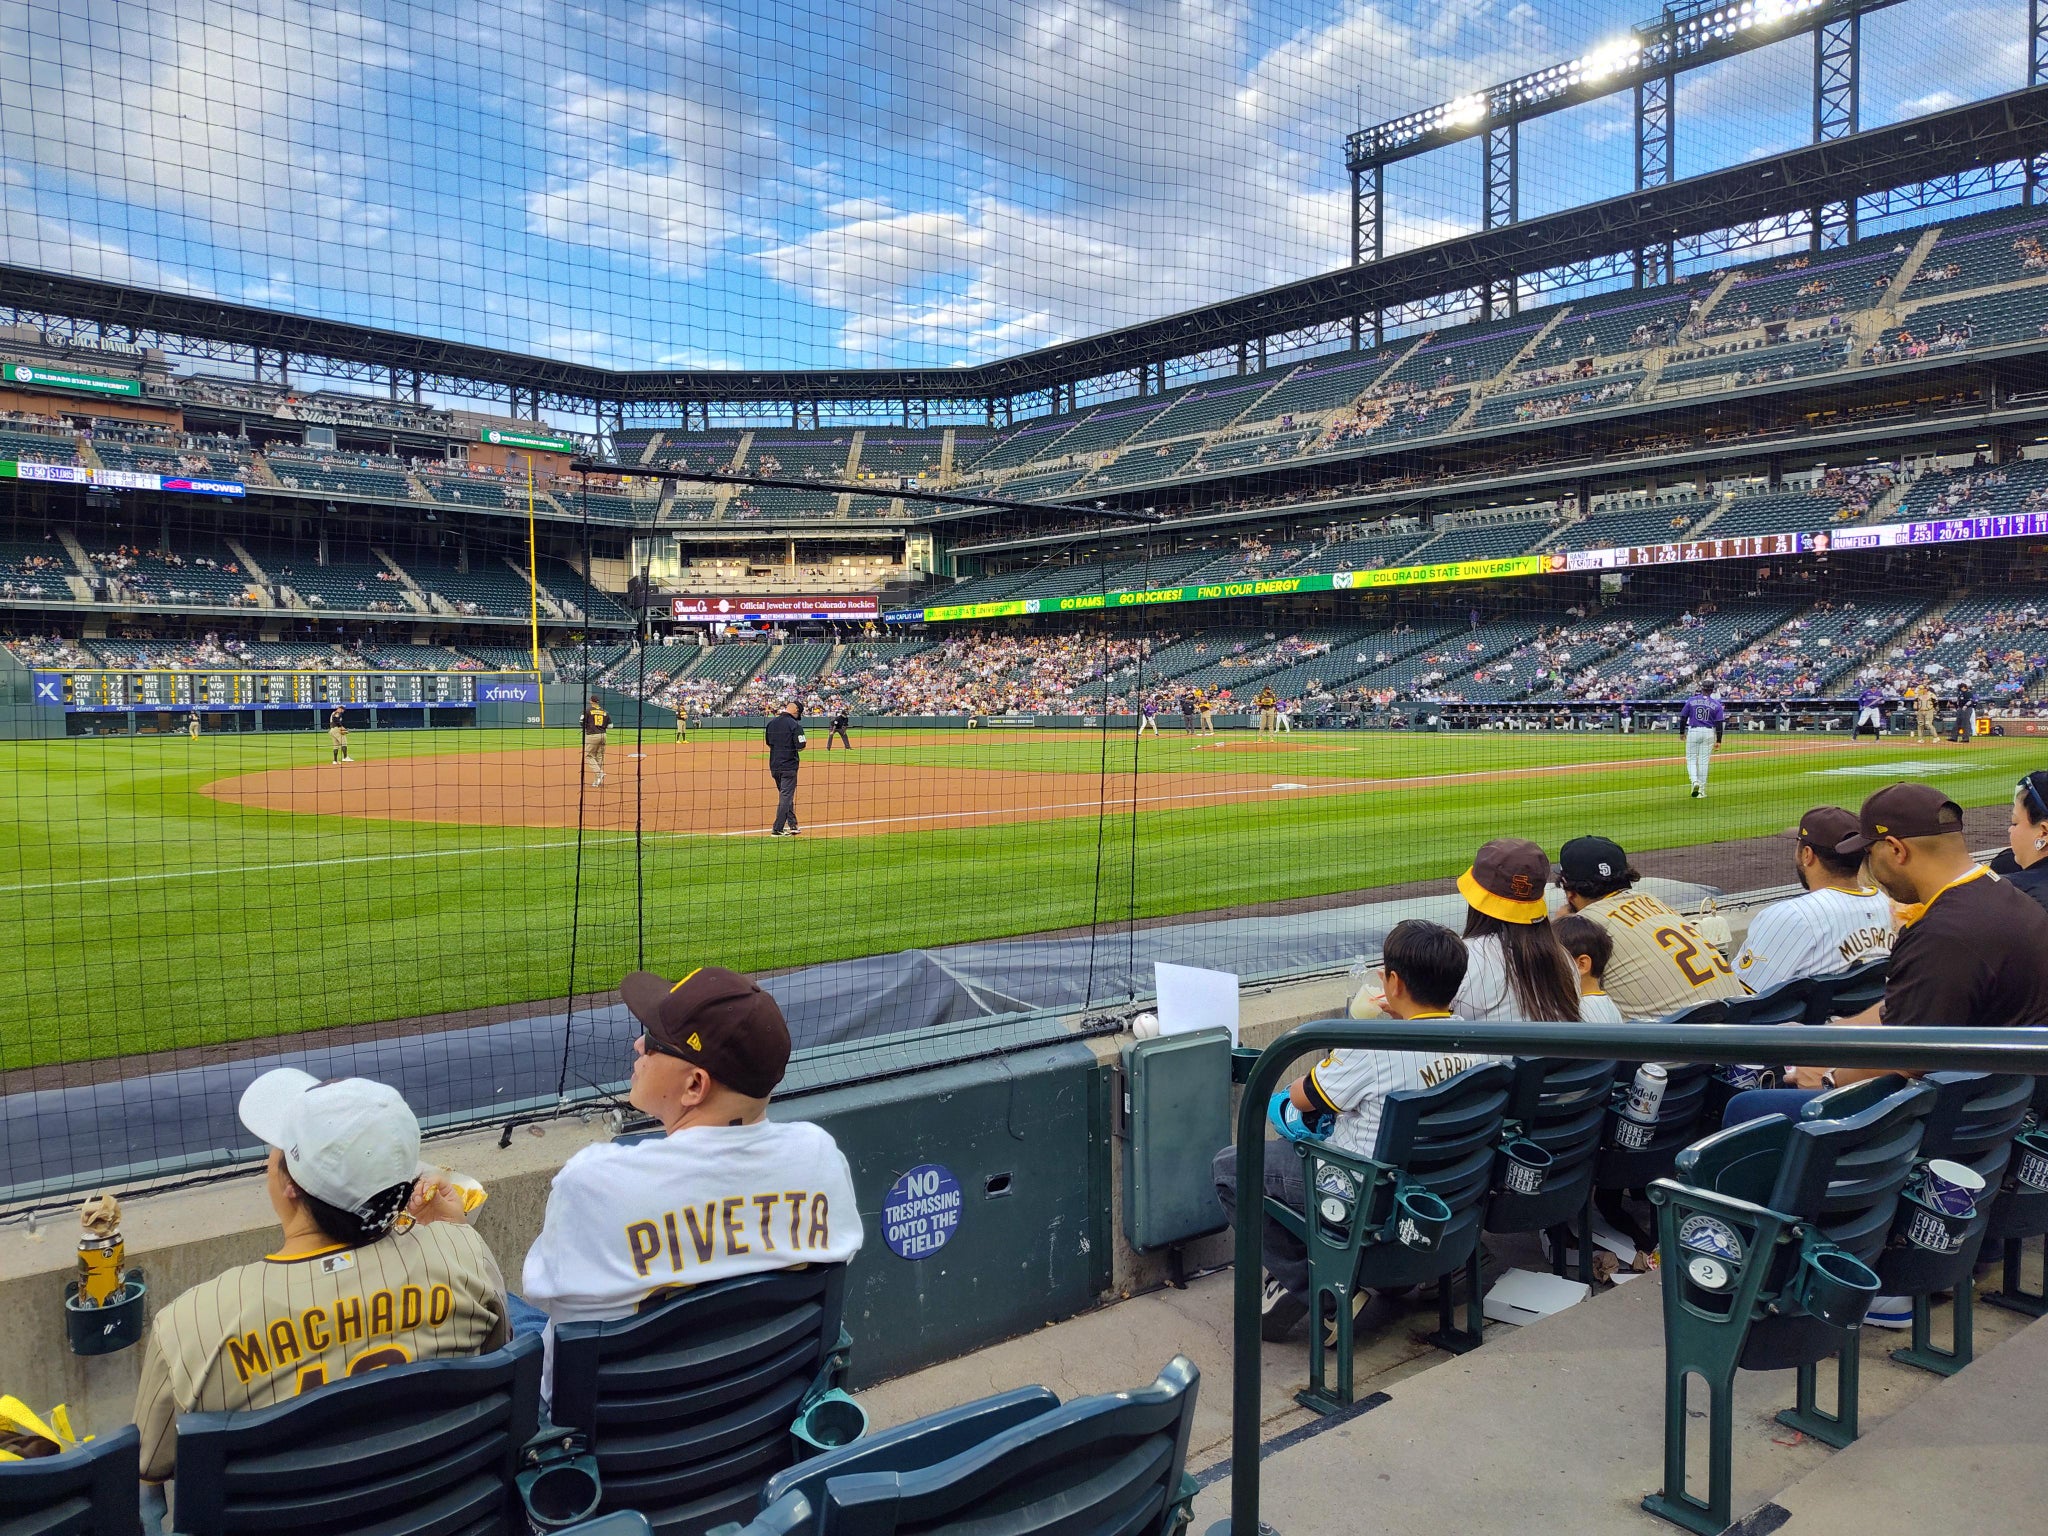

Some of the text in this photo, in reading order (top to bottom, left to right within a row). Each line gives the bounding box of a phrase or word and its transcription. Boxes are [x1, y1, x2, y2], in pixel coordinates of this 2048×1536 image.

[69, 333, 99, 349] JACK
[34, 372, 70, 384] COLORADO
[92, 380, 130, 391] UNIVERSITY
[298, 408, 339, 425] Silver
[339, 418, 360, 426] BULLET
[502, 436, 524, 444] COLORADO
[192, 482, 243, 494] EMPOWER
[1940, 528, 1969, 540] 20/79
[2017, 523, 2024, 533] 3
[2035, 522, 2046, 532] 11
[1834, 535, 1876, 548] RUMFIELD
[1911, 530, 1931, 542] .253
[1686, 549, 1702, 560] 22.1
[1716, 548, 1721, 557] 6
[1756, 545, 1761, 554] 8
[1776, 543, 1787, 552] 25
[1659, 551, 1676, 562] 2.42
[1373, 569, 1427, 583] COLORADO
[1429, 566, 1460, 578] STATE
[1464, 561, 1529, 575] UNIVERSITY
[1060, 579, 1301, 609] GO RAMS! GO ROCKIES! FIND YOUR ENERGY
[766, 602, 793, 610] Jeweler
[928, 609, 957, 618] COLORADO
[977, 605, 1012, 614] UNIVERSITY
[485, 687, 527, 700] xfinity
[594, 715, 603, 726] 13
[1696, 706, 1710, 720] 81
[1608, 896, 1664, 928] TATIS
[1619, 1121, 1643, 1137] COORS
[1617, 1130, 1641, 1147] FIELD
[1509, 1162, 1535, 1181] COORS
[2020, 1166, 2048, 1189] FIEL
[908, 1170, 940, 1200] NO
[1507, 1172, 1533, 1192] FIELD
[885, 1190, 960, 1224] TRESPASSING
[889, 1210, 957, 1241] ONTO THE
[1916, 1213, 1949, 1236] COOR
[625, 1190, 829, 1278] PIVETTA
[1912, 1226, 1950, 1250] FIELD
[903, 1230, 945, 1257] FIELD
[1702, 1266, 1713, 1280] 2
[226, 1283, 452, 1384] MACHADO
